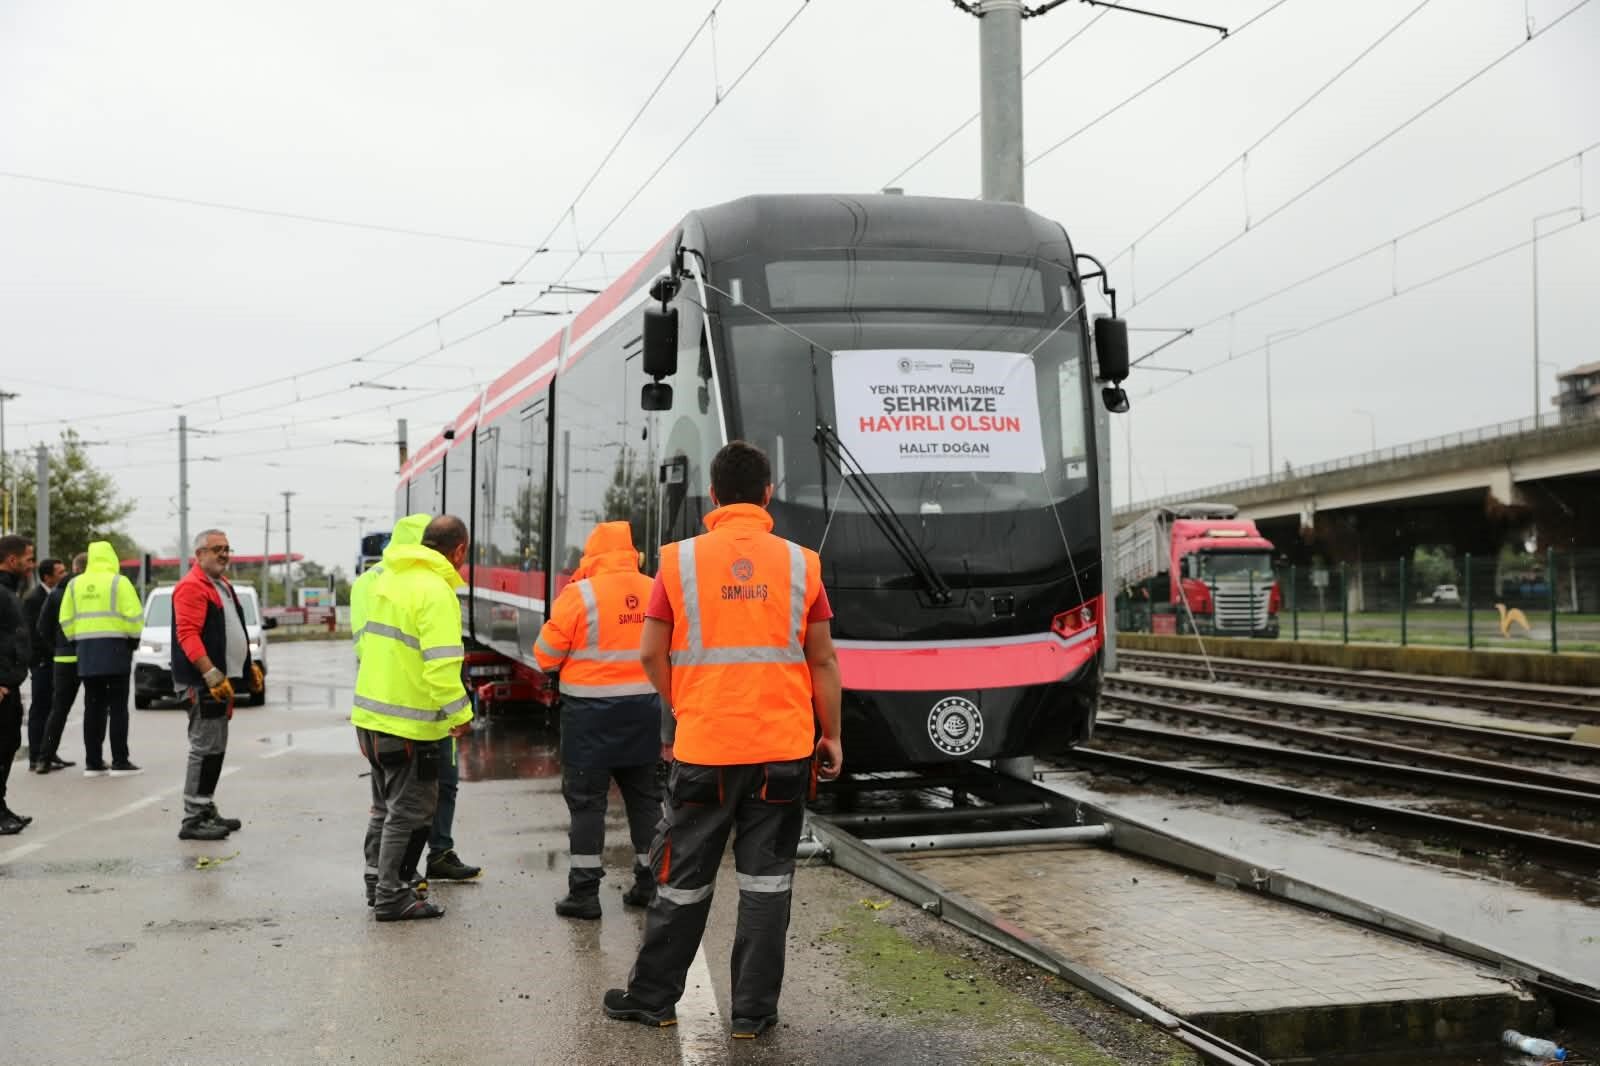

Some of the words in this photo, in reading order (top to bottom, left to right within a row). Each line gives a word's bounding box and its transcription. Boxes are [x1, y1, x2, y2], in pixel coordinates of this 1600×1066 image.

[870, 384, 898, 395] YENİ
[902, 384, 1006, 395] TRAMVAYLARIMIZ
[883, 396, 997, 415] ŞEHRİMİZE
[860, 415, 945, 432] HAYIRLI
[950, 415, 1021, 432] OLSUN
[900, 442, 938, 453] HALİT
[942, 441, 990, 453] DOĞAN
